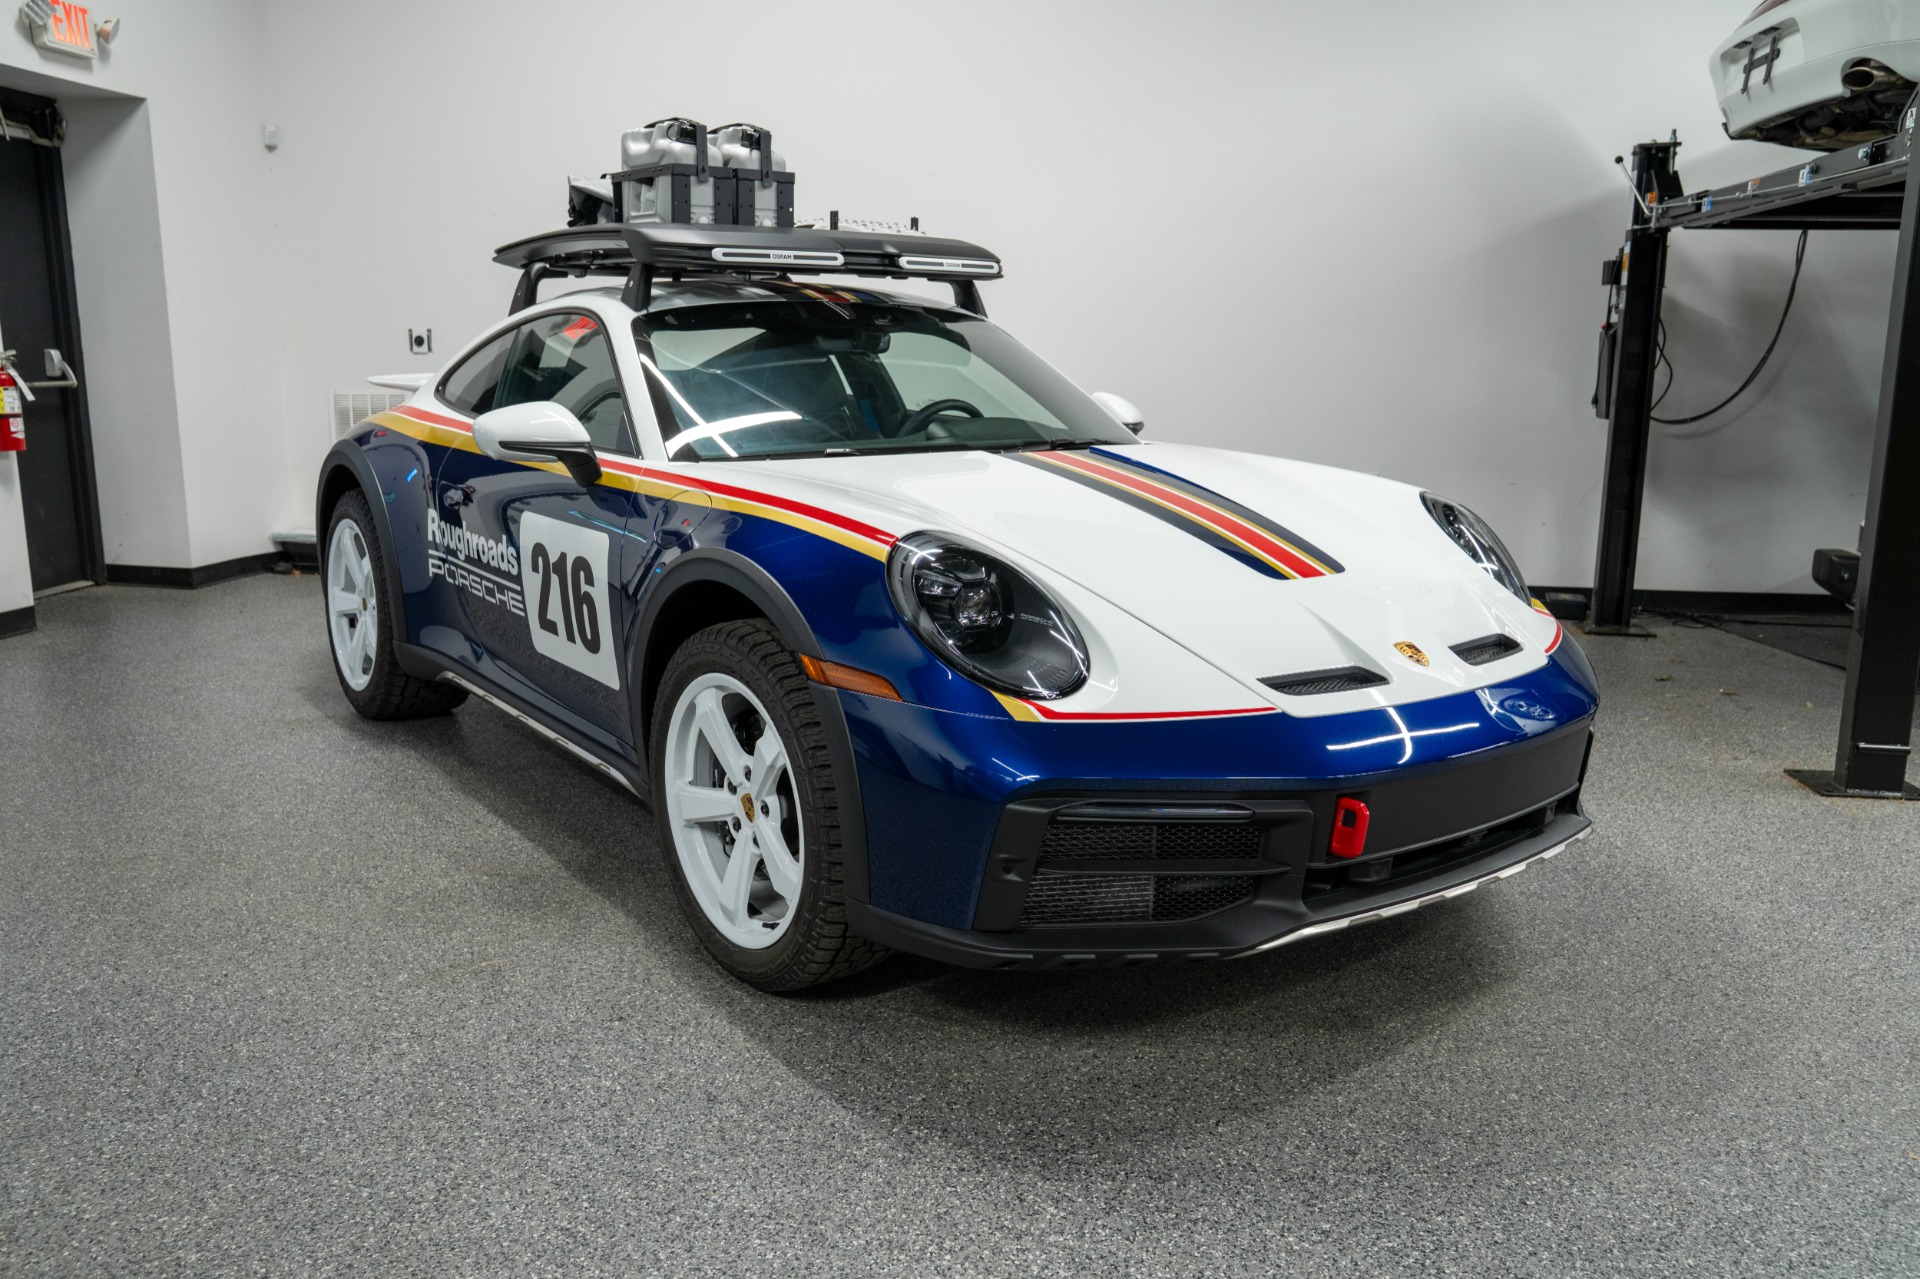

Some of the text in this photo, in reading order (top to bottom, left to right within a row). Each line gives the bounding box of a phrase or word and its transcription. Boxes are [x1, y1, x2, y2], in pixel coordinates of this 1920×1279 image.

[50, 0, 91, 48] EXIT
[428, 508, 519, 576] Roughroads
[428, 558, 525, 617] PORSCHE
[531, 542, 601, 655] 216
